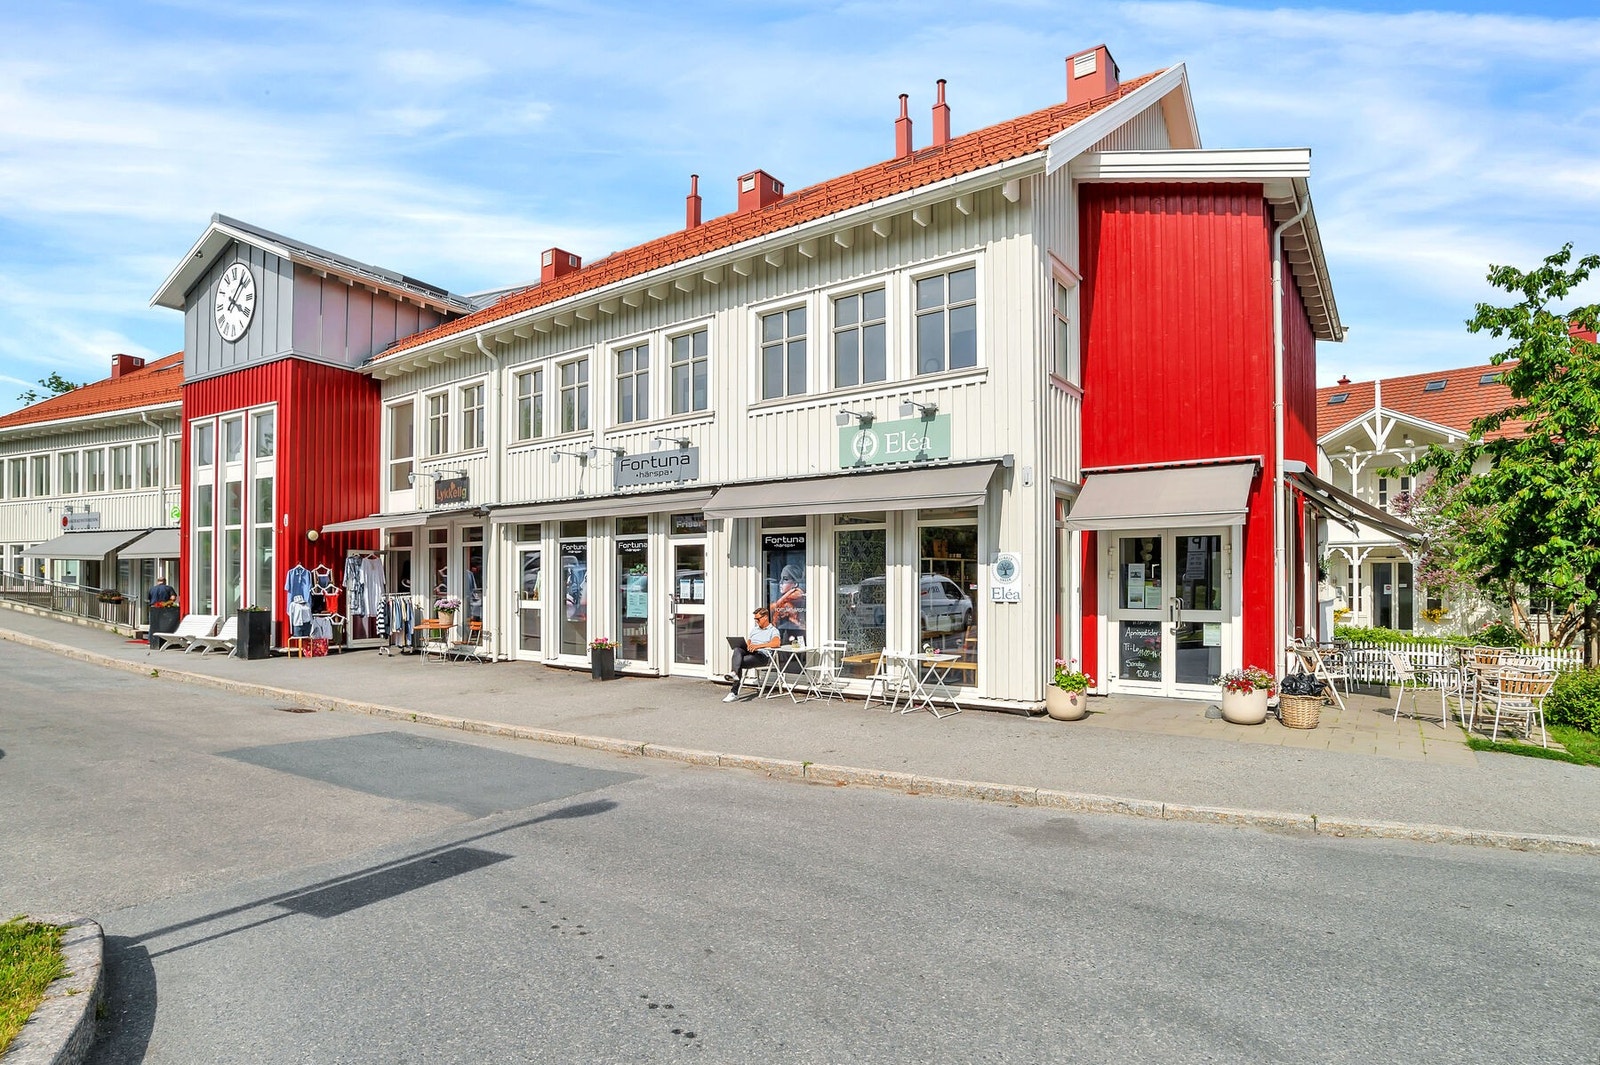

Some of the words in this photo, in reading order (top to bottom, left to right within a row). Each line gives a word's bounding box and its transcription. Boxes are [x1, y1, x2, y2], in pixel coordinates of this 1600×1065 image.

[884, 430, 932, 454] Eléa
[620, 454, 690, 472] Fortuna
[764, 536, 805, 544] Fortuna
[992, 586, 1020, 600] Eléa
